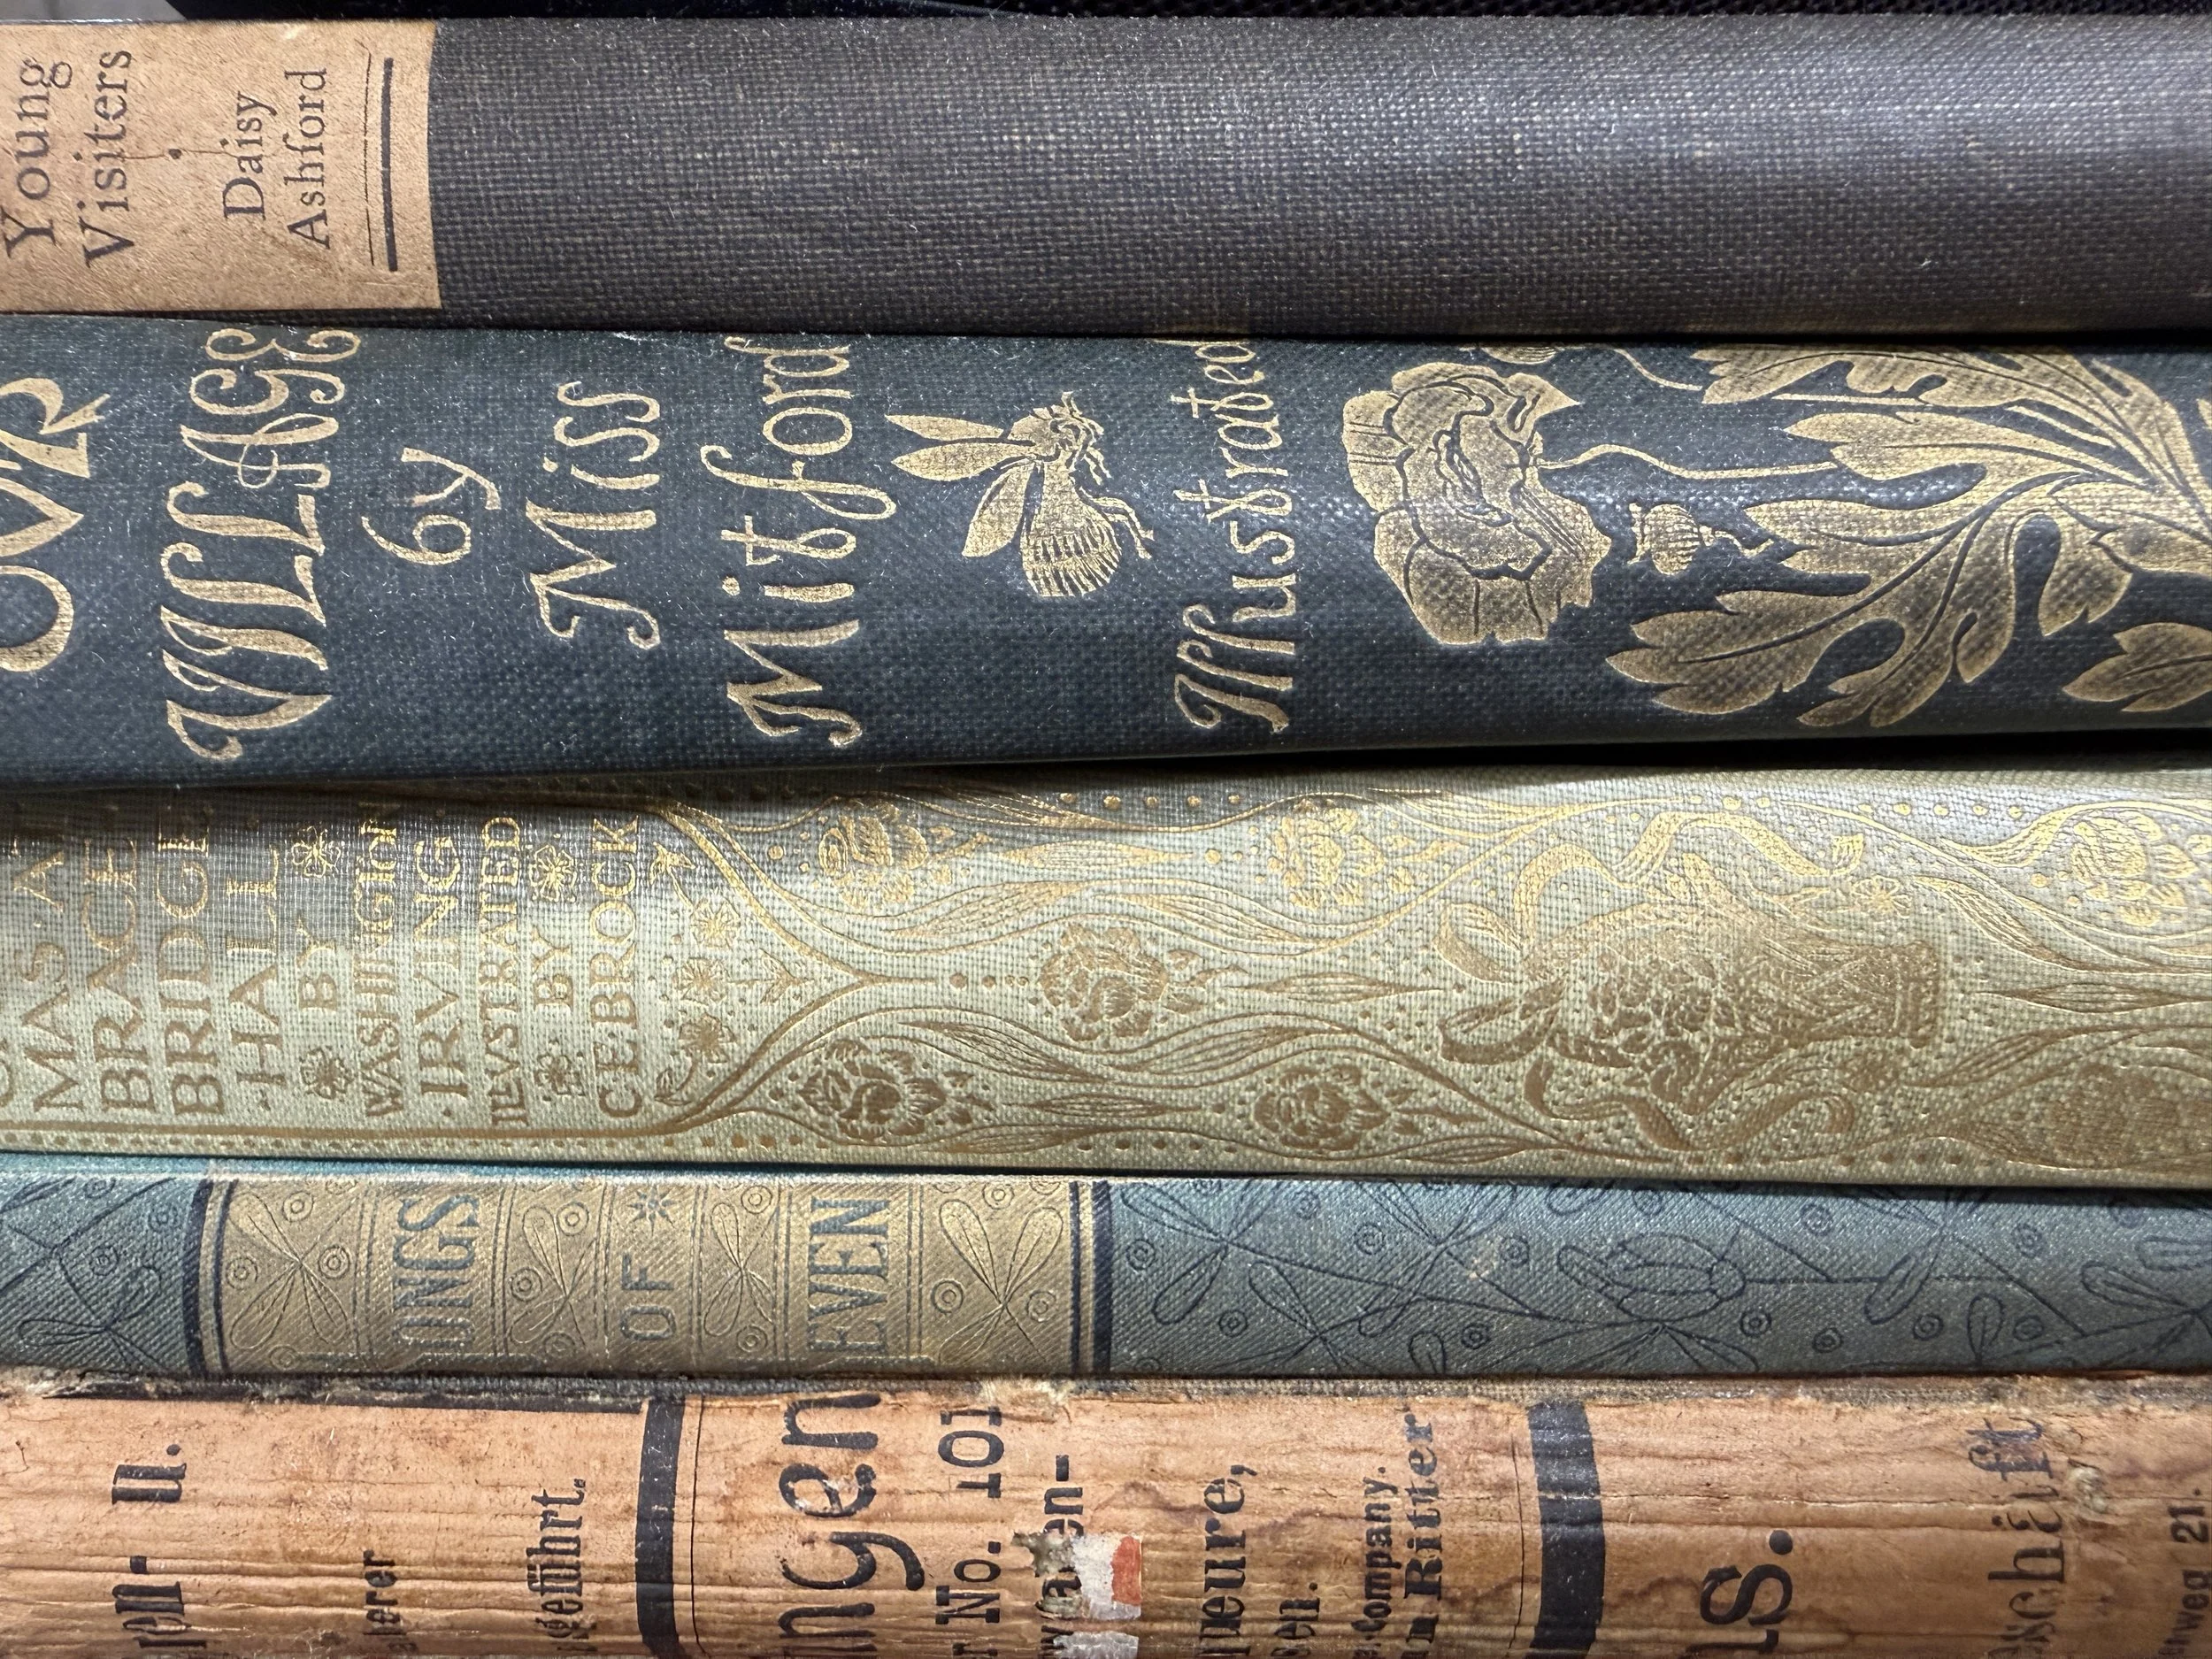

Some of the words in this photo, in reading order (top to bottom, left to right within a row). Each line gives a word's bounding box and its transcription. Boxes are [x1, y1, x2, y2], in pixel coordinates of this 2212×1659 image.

[2, 58, 73, 257] Young
[78, 50, 134, 266] Visiters
[220, 91, 277, 219] Daisy
[284, 67, 331, 250] Ashford
[160, 327, 361, 761] VILLAGE
[361, 447, 502, 565] by
[526, 380, 661, 650] Miss
[701, 335, 897, 748] Mitford
[296, 915, 339, 1013] BY
[531, 927, 575, 1014] BY
[620, 1254, 678, 1342] OF
[937, 1405, 1005, 1499] 101
[1403, 1412, 1444, 1602] Ritter
[2166, 1486, 2211, 1544] 21.
[934, 1540, 1002, 1624] No.
